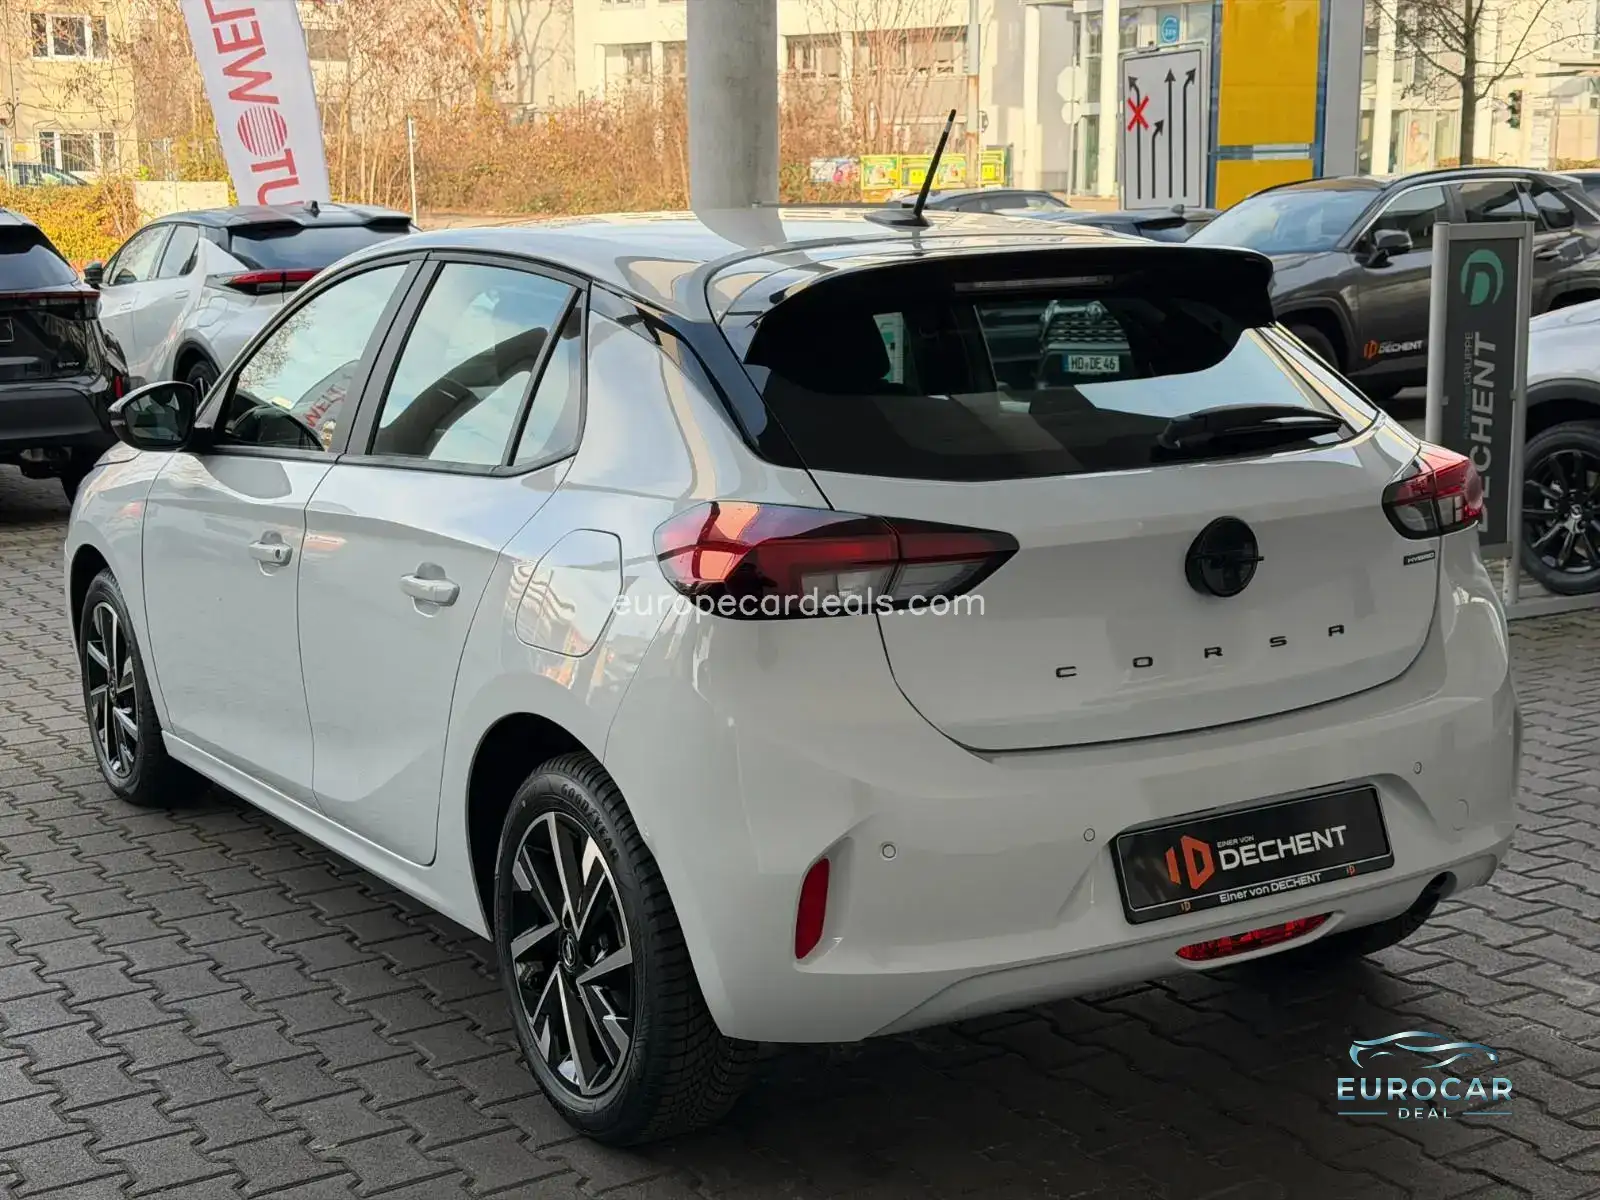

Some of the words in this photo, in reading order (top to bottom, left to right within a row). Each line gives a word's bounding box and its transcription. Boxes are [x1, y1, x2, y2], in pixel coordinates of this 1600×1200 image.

[1055, 624, 1345, 679] CORSA
[1216, 838, 1239, 848] EINER
[1240, 835, 1255, 845] VON
[1218, 825, 1348, 871] DECHENT
[1219, 888, 1249, 903] Einer
[1249, 884, 1270, 898] von
[1270, 872, 1322, 892] DECHENT
